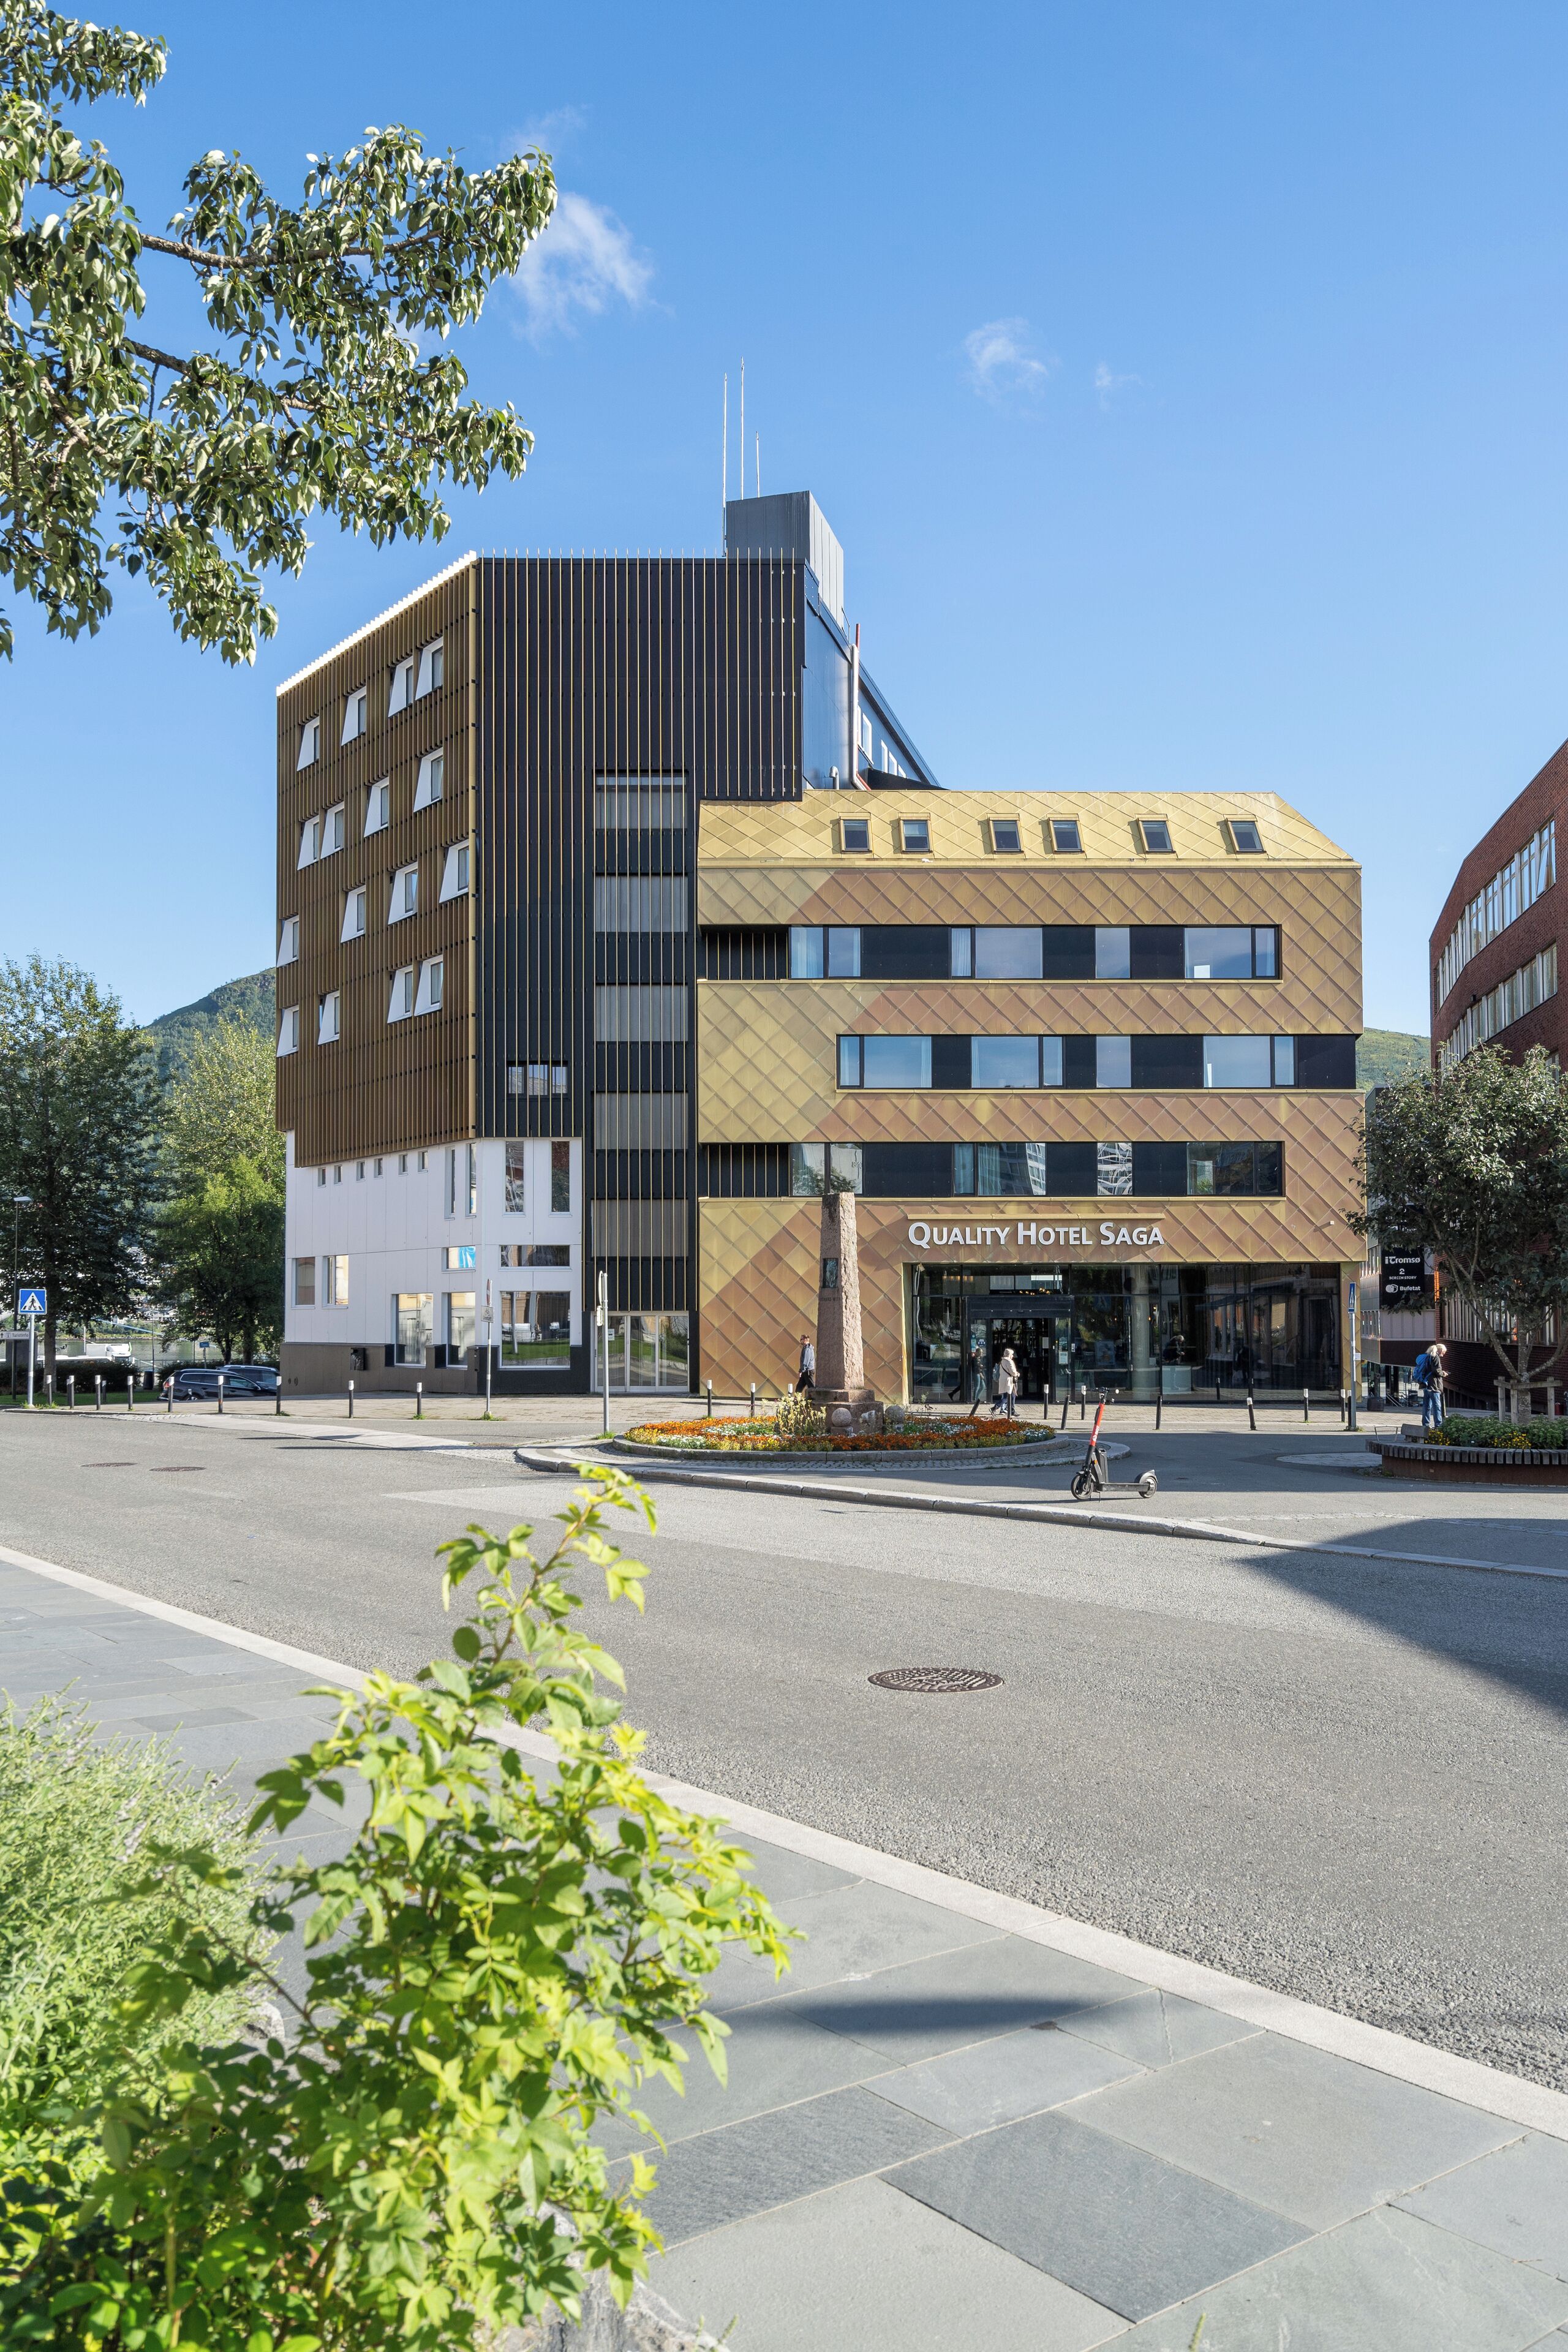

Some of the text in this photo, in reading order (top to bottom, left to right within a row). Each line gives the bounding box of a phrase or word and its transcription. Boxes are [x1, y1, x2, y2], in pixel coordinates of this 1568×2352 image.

[908, 1222, 1164, 1249] QUALITY HOTEL SAGA
